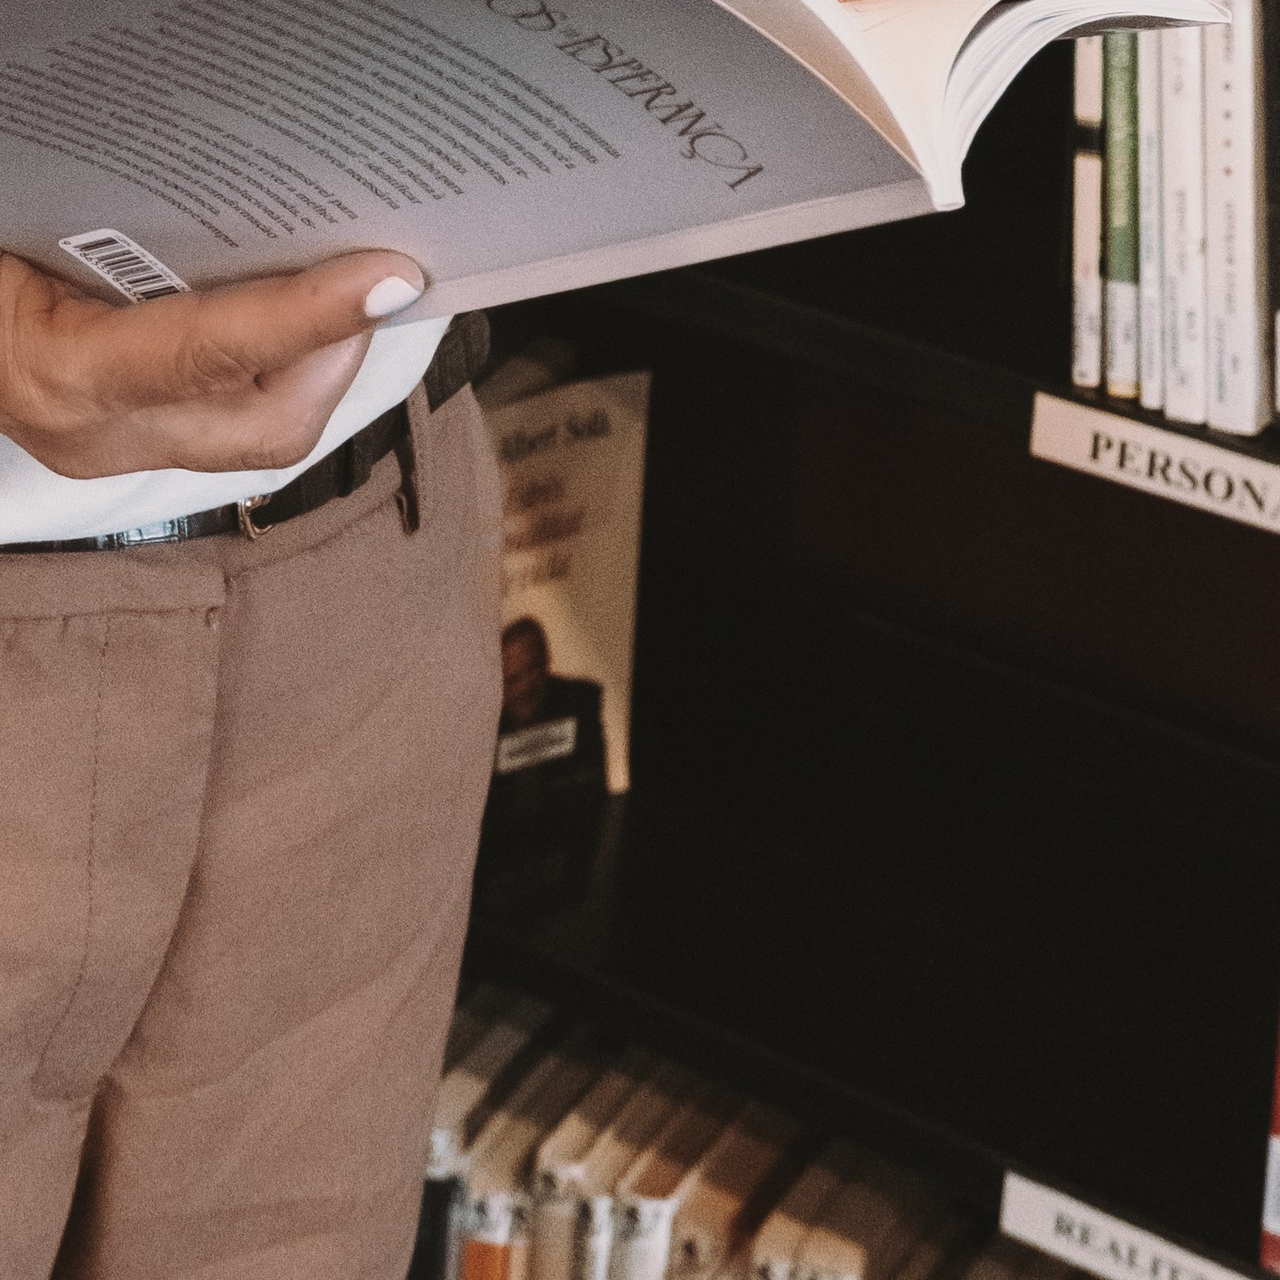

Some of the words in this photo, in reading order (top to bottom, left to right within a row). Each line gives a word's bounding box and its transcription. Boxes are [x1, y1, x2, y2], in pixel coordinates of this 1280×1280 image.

[440, 113, 523, 167] compartilha
[478, 76, 564, 128] Combinando
[550, 127, 604, 165] insights
[491, 105, 549, 141] convida
[538, 139, 573, 162] você
[557, 34, 764, 190] ESPERANÇA
[574, 120, 627, 159] traumas
[221, 132, 257, 149] guia
[250, 146, 338, 198] indispensável
[328, 198, 360, 220] para
[377, 149, 412, 168] vida
[399, 167, 441, 194] plena
[389, 138, 447, 175] caminho
[434, 174, 466, 196] para
[408, 132, 475, 175] propósito.
[437, 131, 514, 186] inspiradoras
[196, 182, 282, 239] transformação
[211, 174, 302, 235] revolucionária,
[239, 174, 308, 217] renomada,
[256, 166, 292, 185] viver
[296, 191, 342, 224] melhor
[344, 166, 405, 209] necessária
[365, 160, 426, 205] identificar
[195, 217, 239, 249] sempre
[1088, 431, 1280, 515] PERSON
